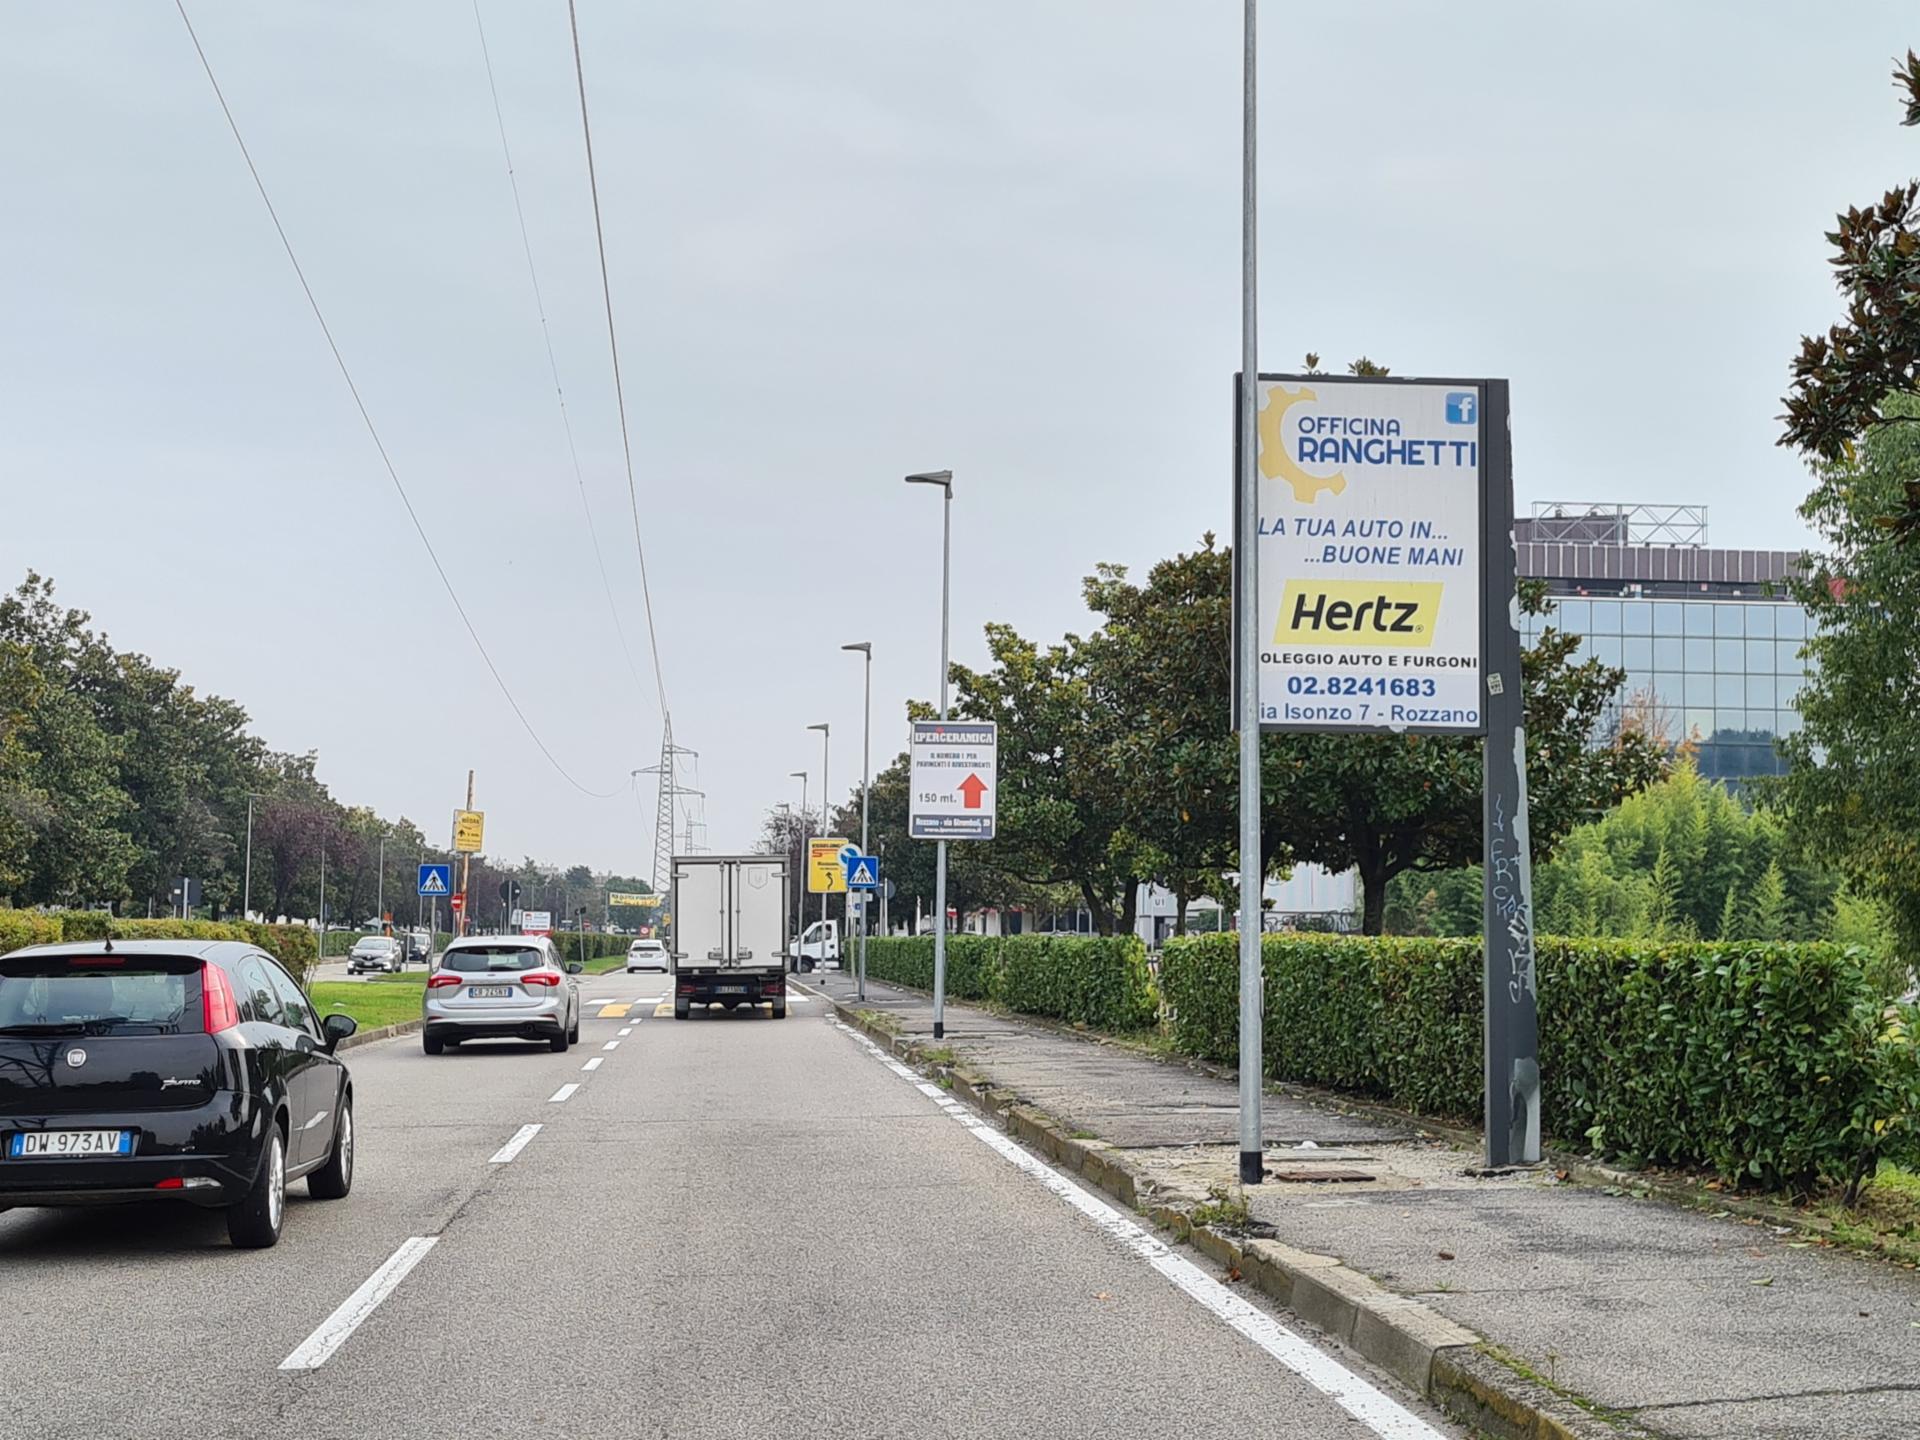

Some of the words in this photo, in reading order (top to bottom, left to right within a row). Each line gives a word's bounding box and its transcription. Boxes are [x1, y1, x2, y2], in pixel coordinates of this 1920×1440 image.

[1298, 416, 1401, 437] OFFICINA
[1298, 437, 1476, 467] RANGHETTI
[1258, 517, 1286, 536] LA
[1293, 518, 1336, 537] TUA
[1341, 519, 1403, 539] AUTO
[1409, 521, 1449, 540] IN...
[1303, 545, 1401, 565] ...BUONE
[1407, 547, 1464, 566] MANI
[1291, 593, 1419, 633] Hertz
[1260, 652, 1334, 665] OLEGGIO
[1338, 654, 1383, 666] AUTO
[1388, 655, 1398, 667] E
[1403, 656, 1478, 668] FURGONI
[1287, 676, 1436, 697] 02.8241683
[1260, 702, 1277, 720] ia
[1285, 702, 1352, 721] Isonzo
[1359, 704, 1370, 720] 7
[1391, 704, 1478, 723] Rozzano
[915, 732, 993, 743] IPERCERAMICA
[919, 793, 937, 803] 150
[26, 1134, 50, 1153] DW
[57, 1132, 118, 1152] 973AV
